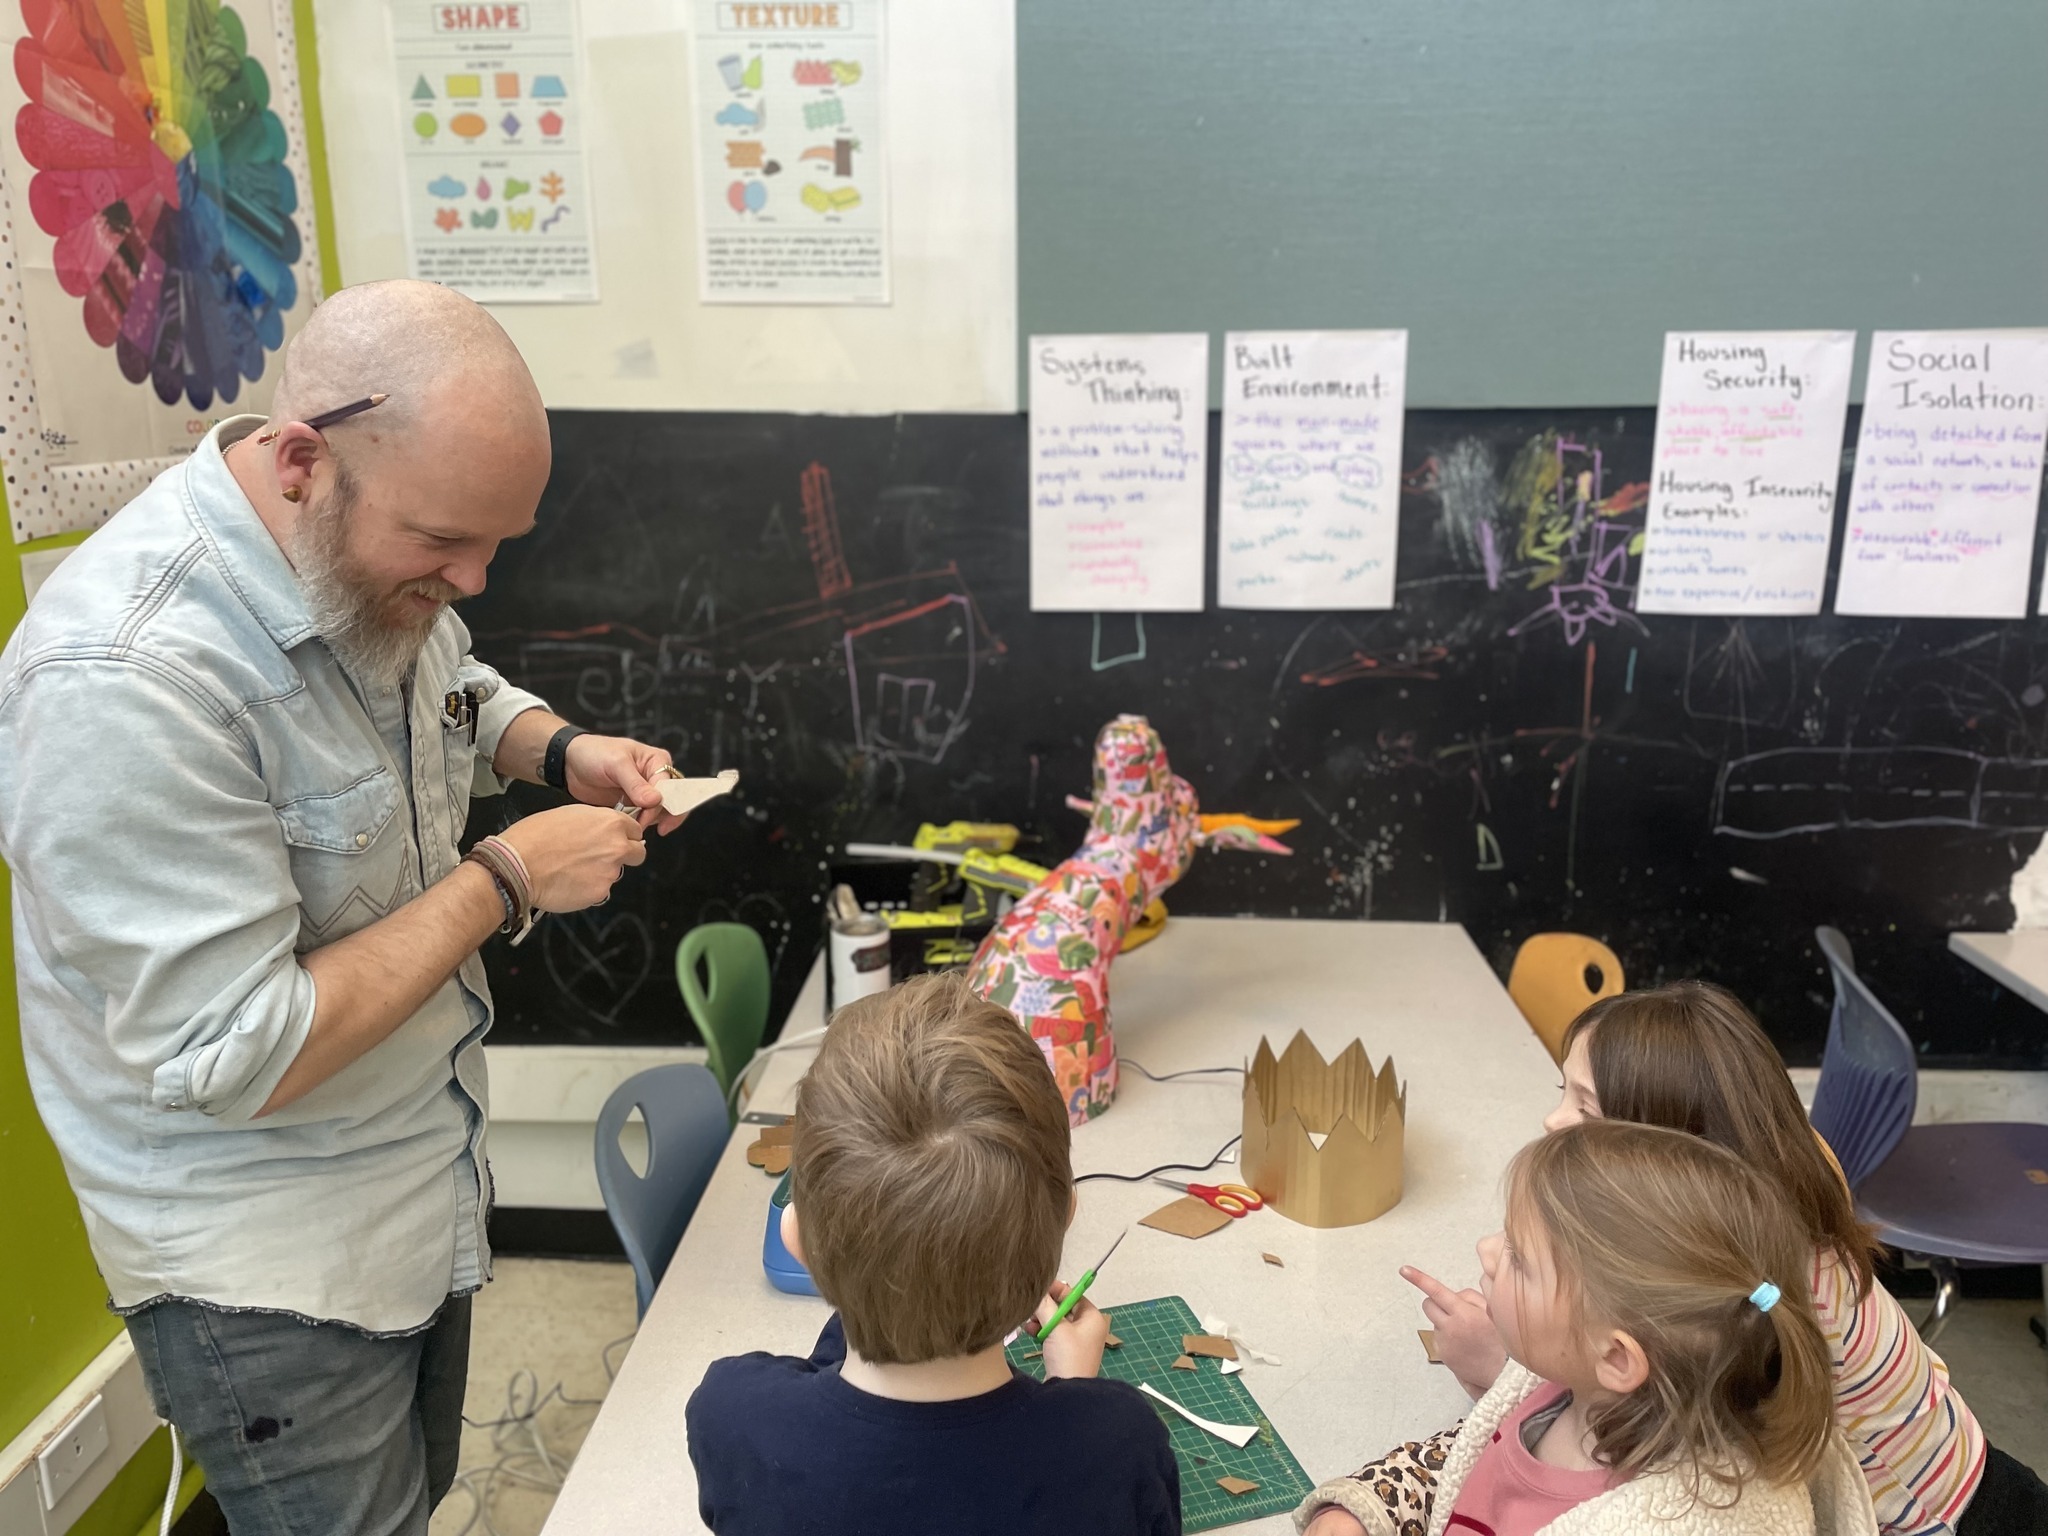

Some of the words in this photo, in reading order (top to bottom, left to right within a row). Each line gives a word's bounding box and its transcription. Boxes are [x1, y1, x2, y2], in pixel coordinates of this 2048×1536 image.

[442, 5, 520, 30] SHAPE
[732, 3, 839, 28] TEXTURE
[1040, 347, 1146, 385] Systems
[1235, 343, 1295, 371] Built
[1678, 338, 1769, 373] Housing
[1887, 339, 1990, 373] Social
[1874, 421, 1919, 449] being
[1930, 422, 2007, 443] detached
[2012, 423, 2042, 443] from
[1866, 454, 1877, 466] a
[1883, 450, 1925, 466] social
[1658, 470, 1735, 503] Housing
[1744, 475, 1834, 513] Insecurity
[1861, 474, 1879, 492] of
[1857, 497, 1885, 514] with
[1891, 498, 1935, 513] others
